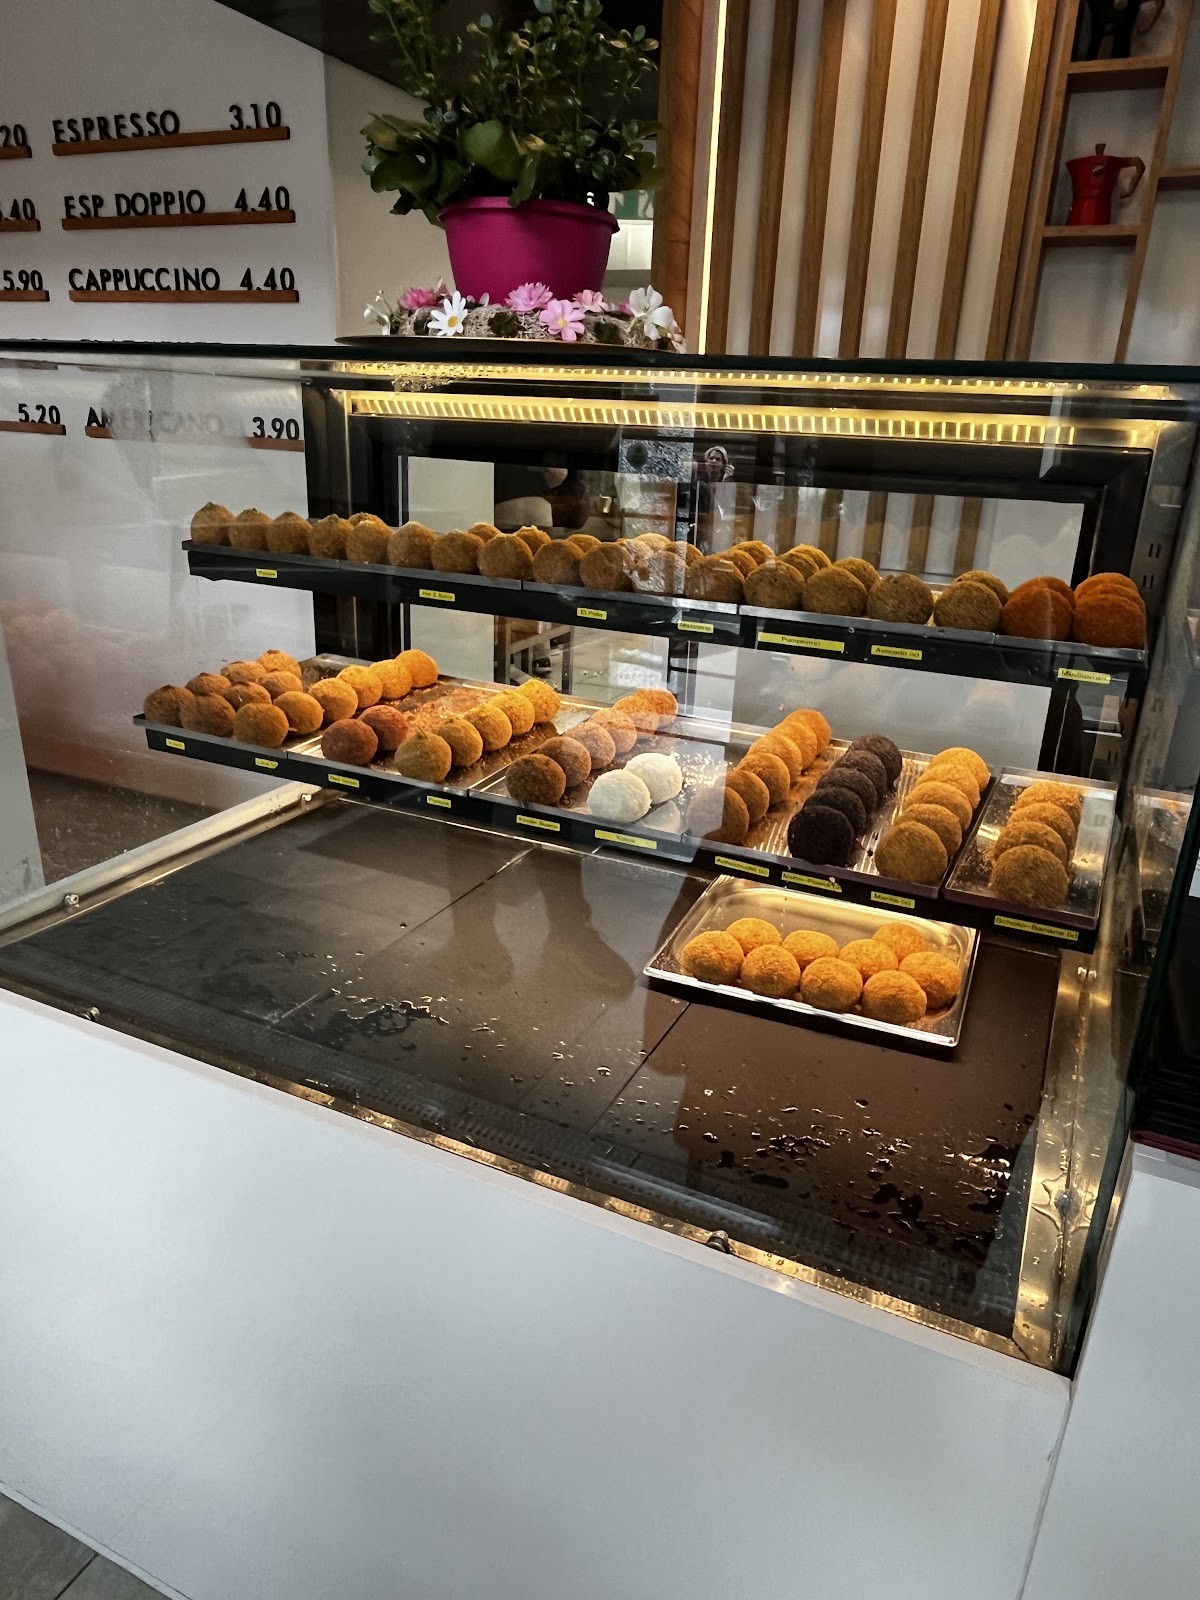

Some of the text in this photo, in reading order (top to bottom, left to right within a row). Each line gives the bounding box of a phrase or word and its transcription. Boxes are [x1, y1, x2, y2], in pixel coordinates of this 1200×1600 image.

[52, 101, 282, 144] ESPRESSO 3.10
[63, 186, 290, 219] ESP DOPPIO 4.40
[68, 267, 295, 292] CAPPUCCINO 4.40
[18, 403, 61, 425] 5.20
[252, 417, 300, 441] 3.90
